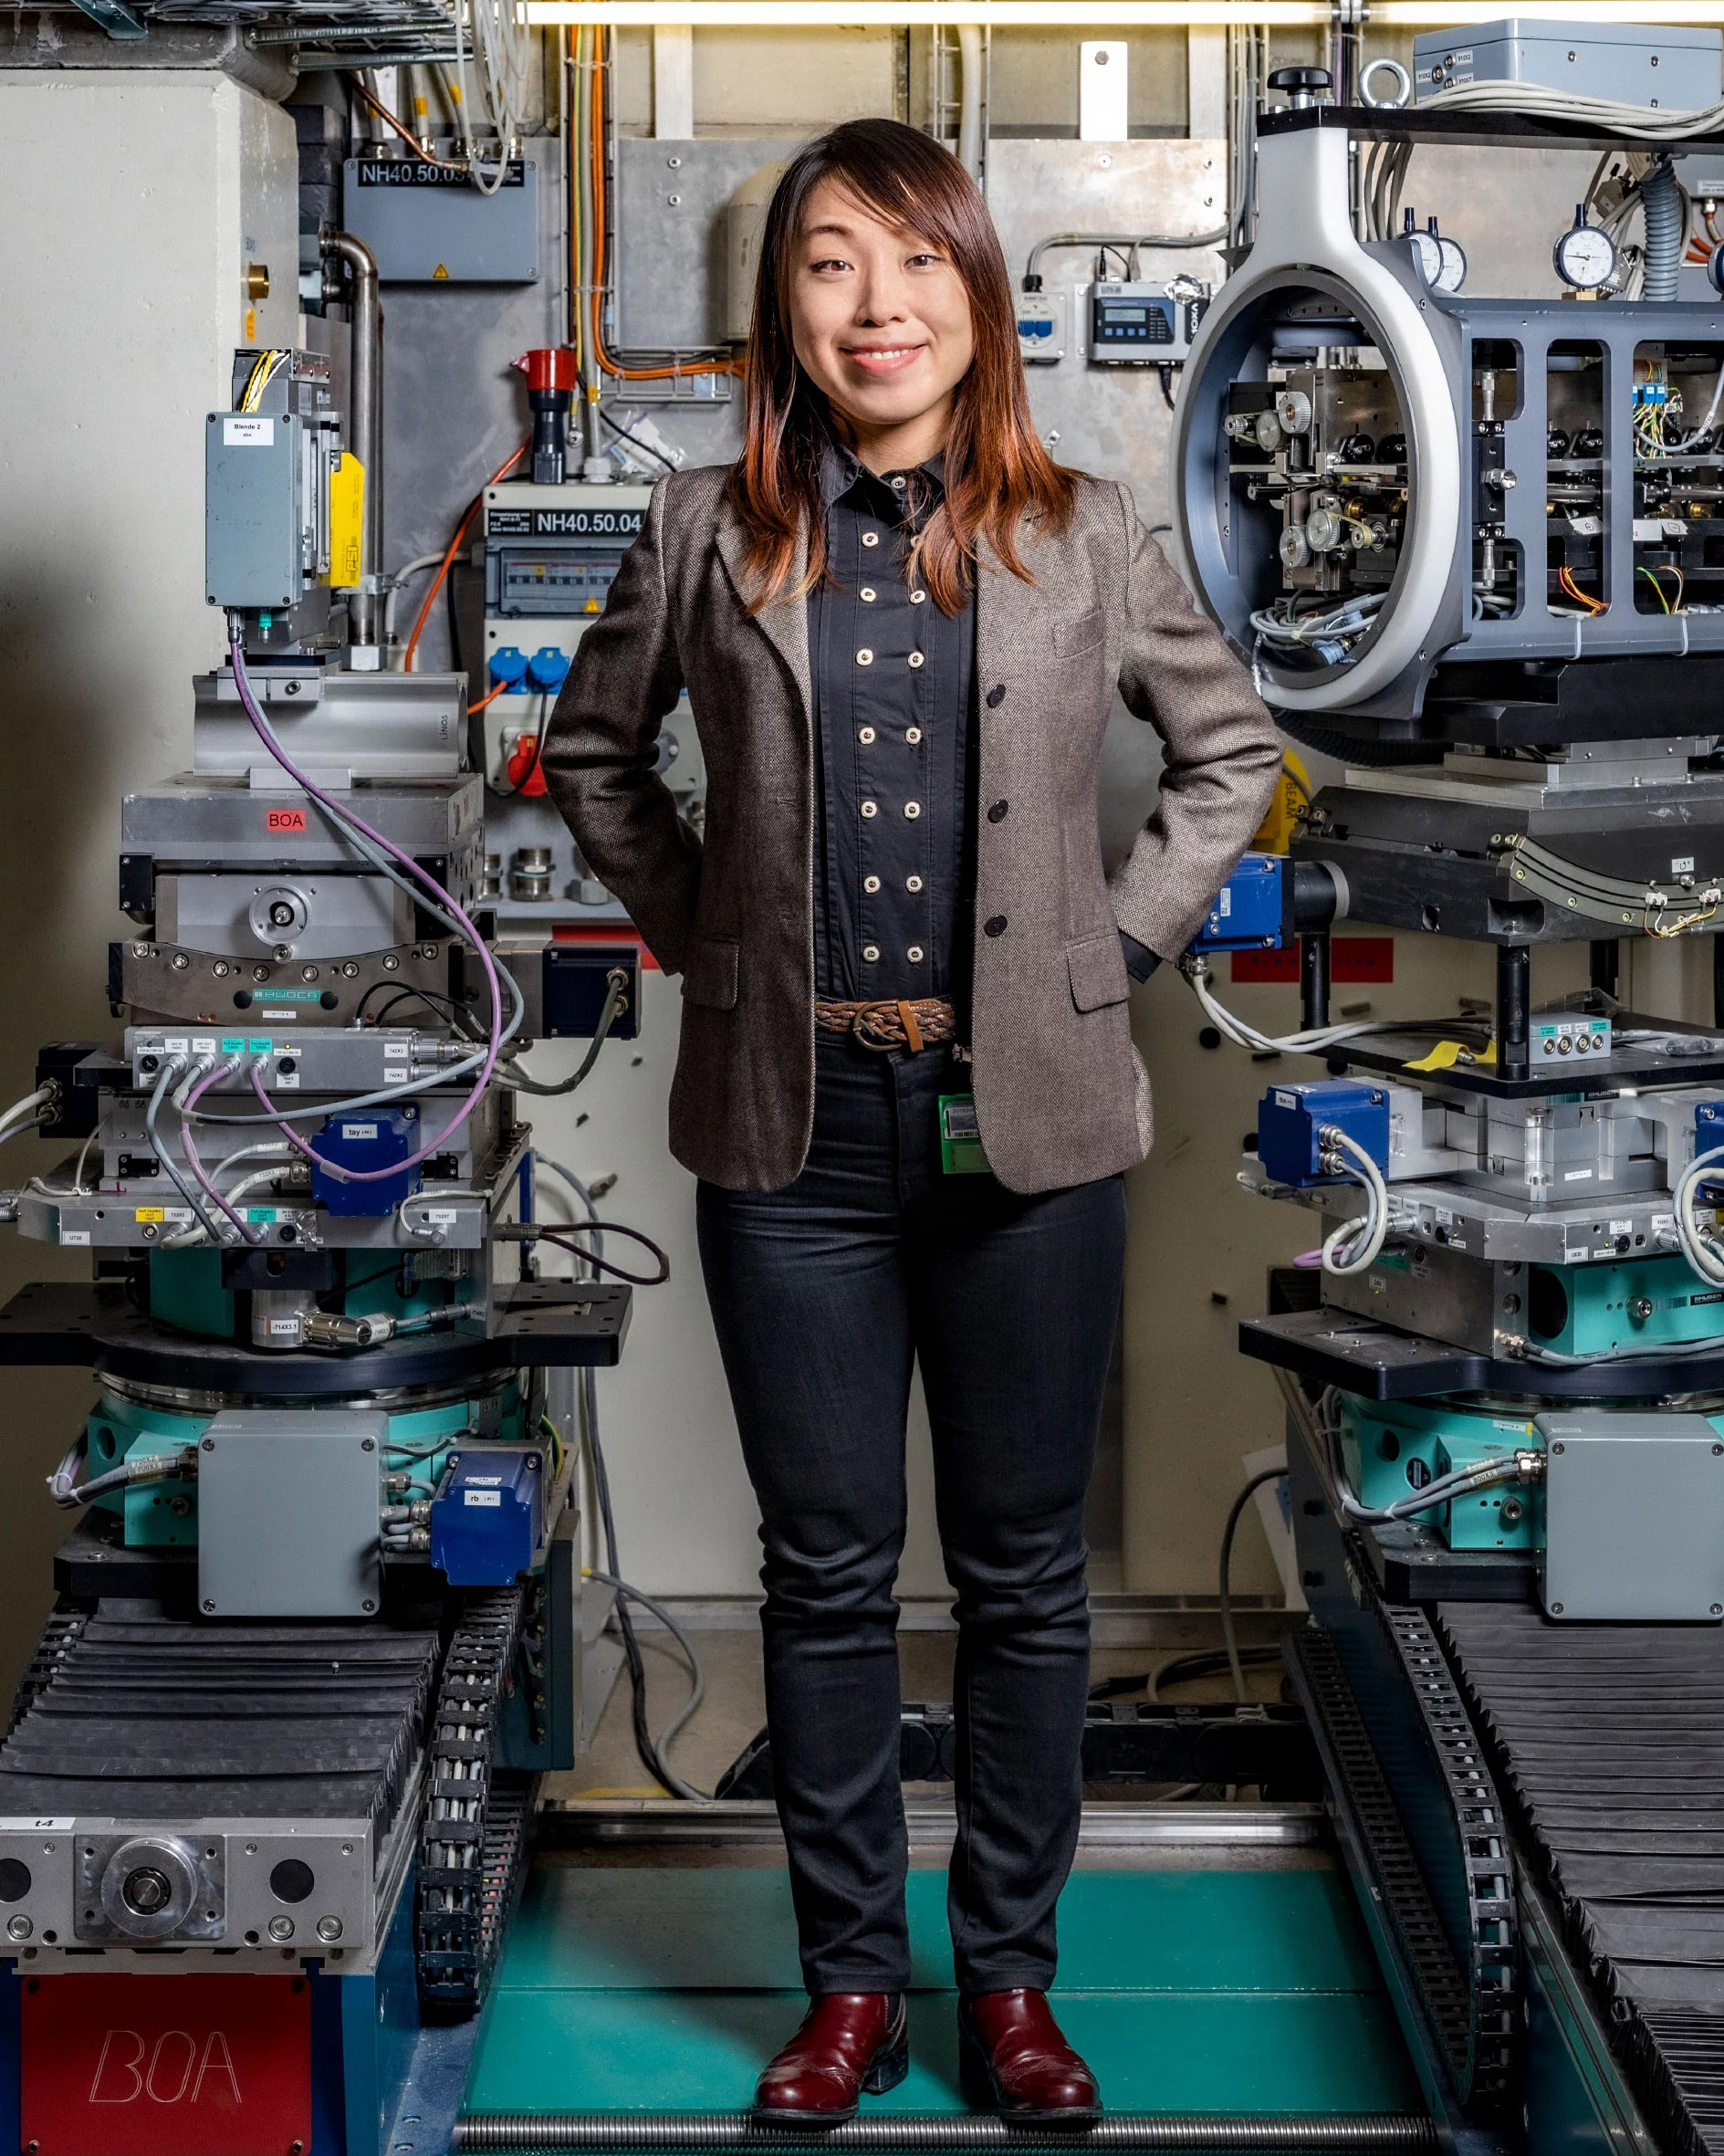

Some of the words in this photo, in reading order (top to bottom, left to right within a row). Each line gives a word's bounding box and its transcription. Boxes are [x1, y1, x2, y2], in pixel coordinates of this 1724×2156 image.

[537, 513, 643, 532] NH40.50.04
[346, 546, 359, 571] PSI
[1286, 782, 1297, 819] BEAM
[269, 813, 303, 827] BOA
[349, 1128, 360, 1136] tay
[1473, 1470, 1494, 1483] 800X3
[89, 2029, 243, 2103] BOA
